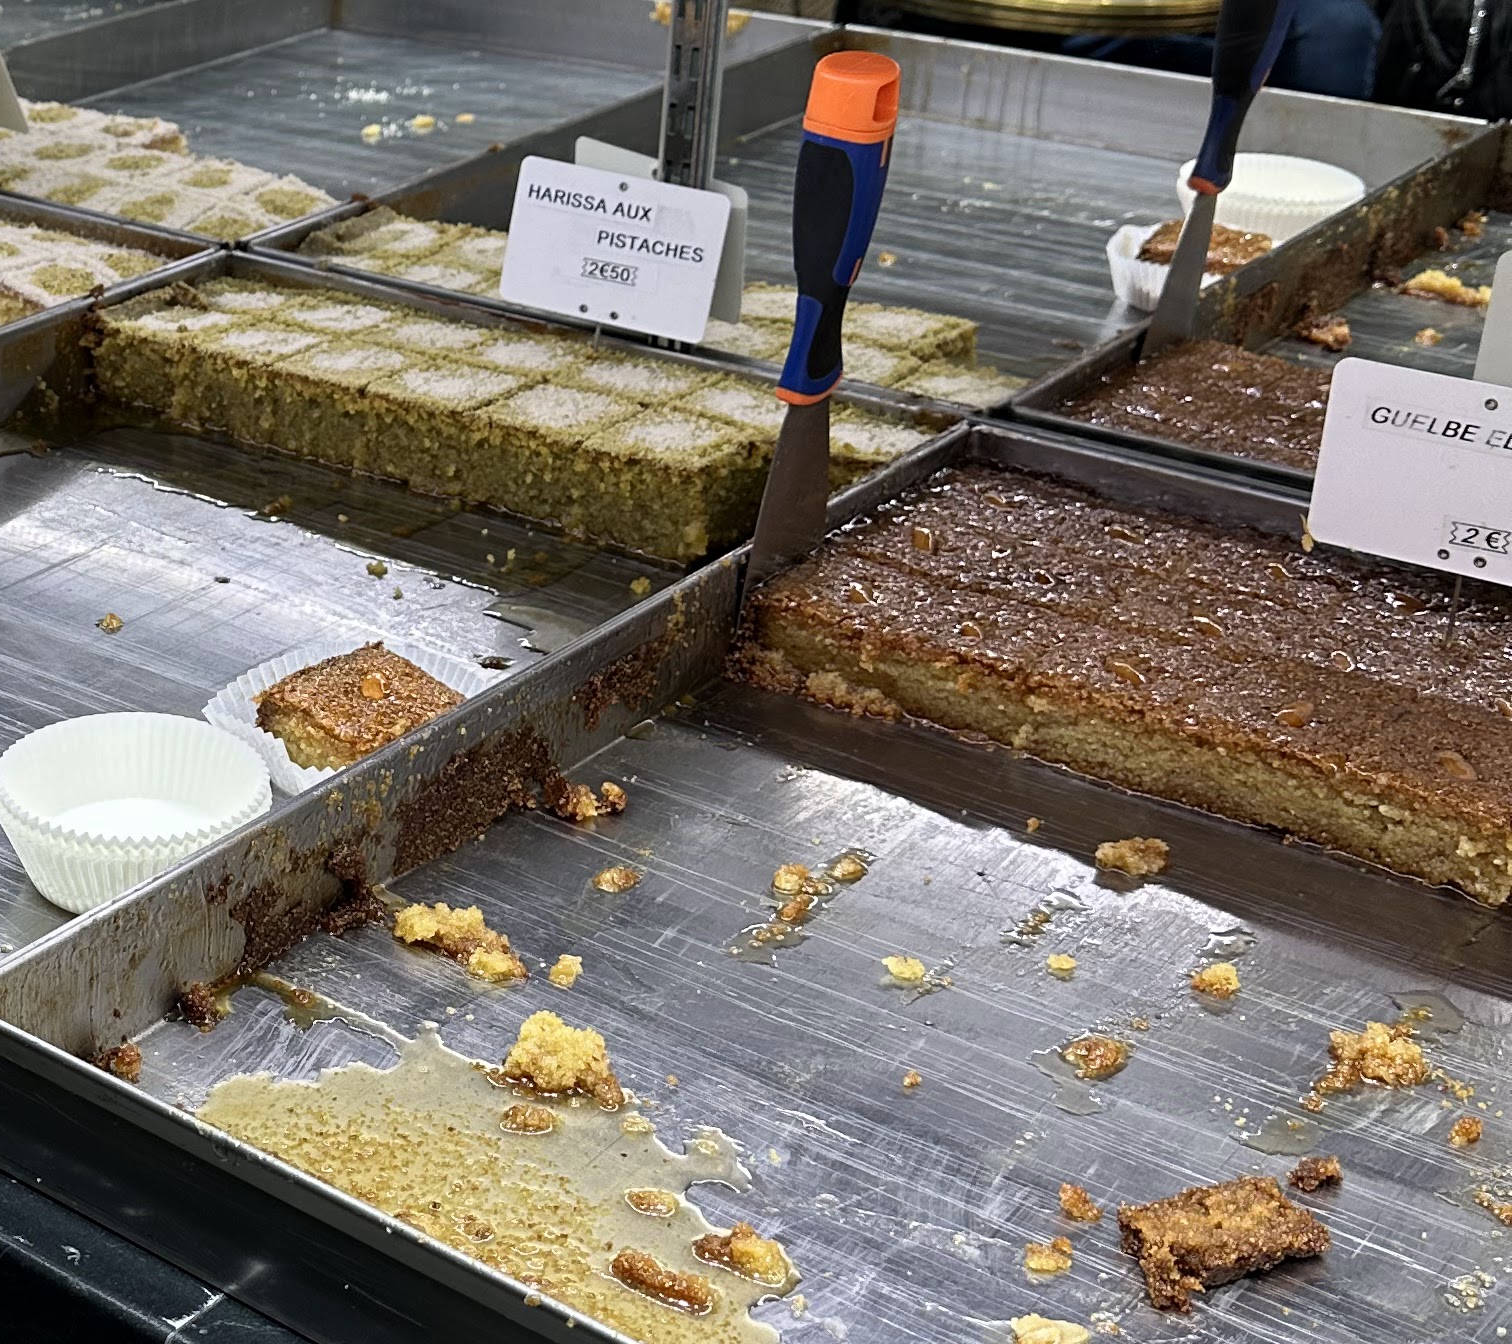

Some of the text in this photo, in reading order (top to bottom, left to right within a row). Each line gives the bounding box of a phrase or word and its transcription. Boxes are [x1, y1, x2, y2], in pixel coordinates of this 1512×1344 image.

[527, 184, 653, 222] HARISSA AUX
[597, 230, 705, 264] PISTACHES
[588, 261, 631, 283] 2€50
[1370, 406, 1512, 450] GUELBE E
[1461, 528, 1502, 550] 2 €
